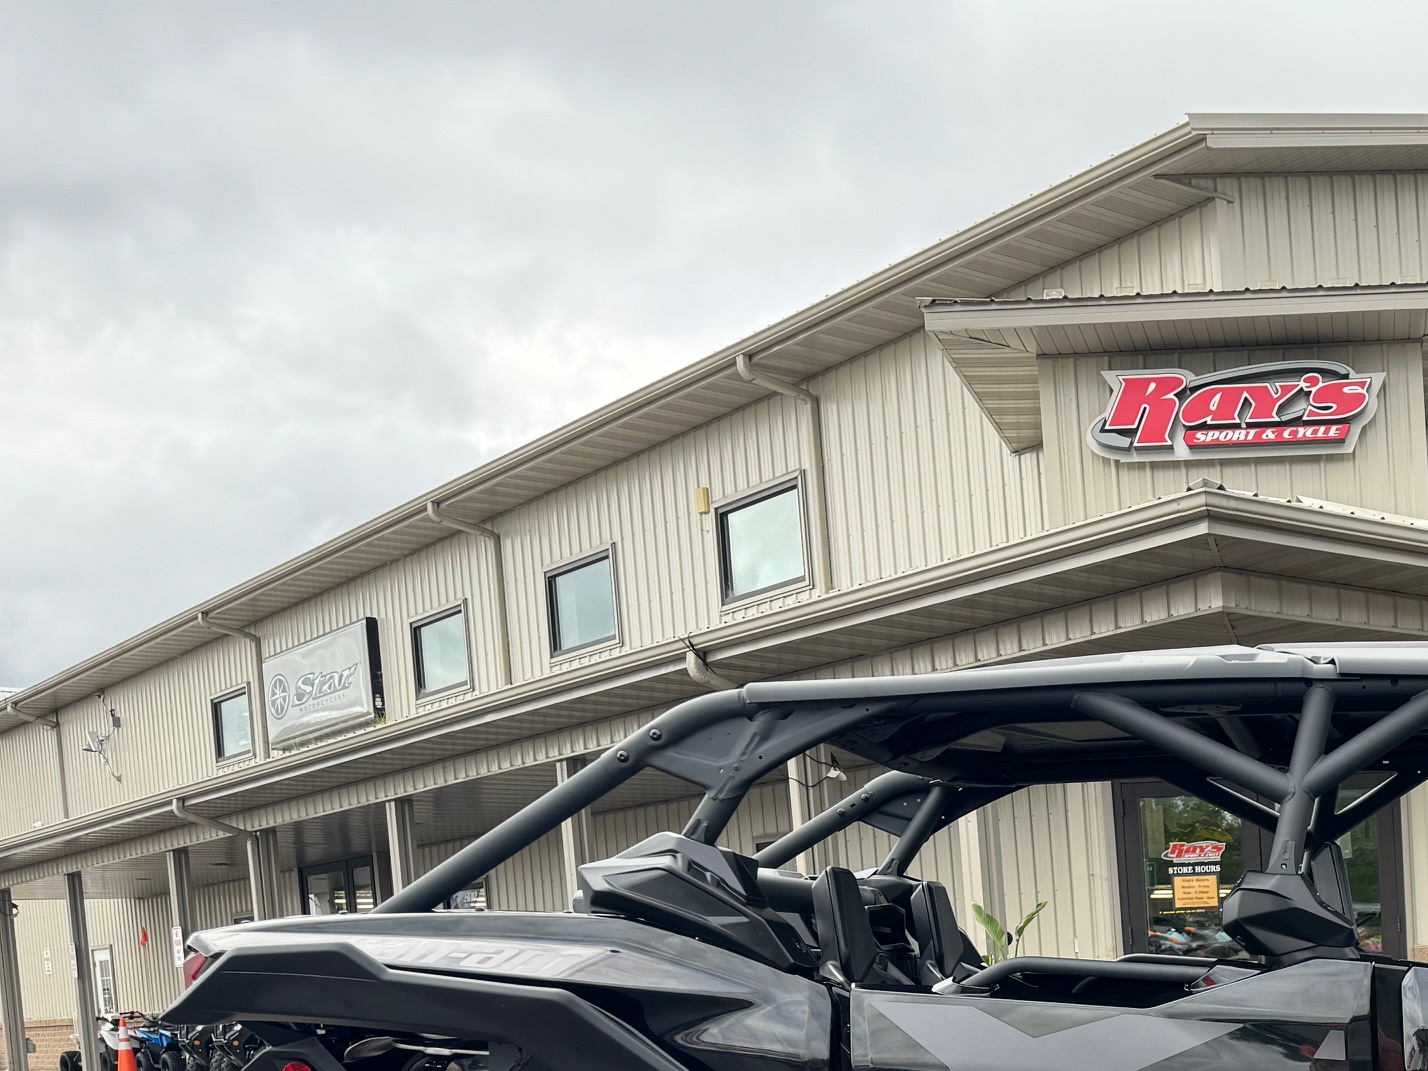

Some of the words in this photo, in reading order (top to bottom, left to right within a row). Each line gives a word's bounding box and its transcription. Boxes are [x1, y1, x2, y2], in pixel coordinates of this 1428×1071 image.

[1105, 372, 1372, 446] Ray's
[1193, 428, 1259, 443] SPORT
[1260, 428, 1277, 440] &
[1282, 425, 1342, 440] CYCLE
[291, 662, 359, 708] Star
[300, 694, 346, 711] MOTORCYCLES
[1168, 866, 1194, 875] STORE
[1195, 864, 1221, 873] HOURS
